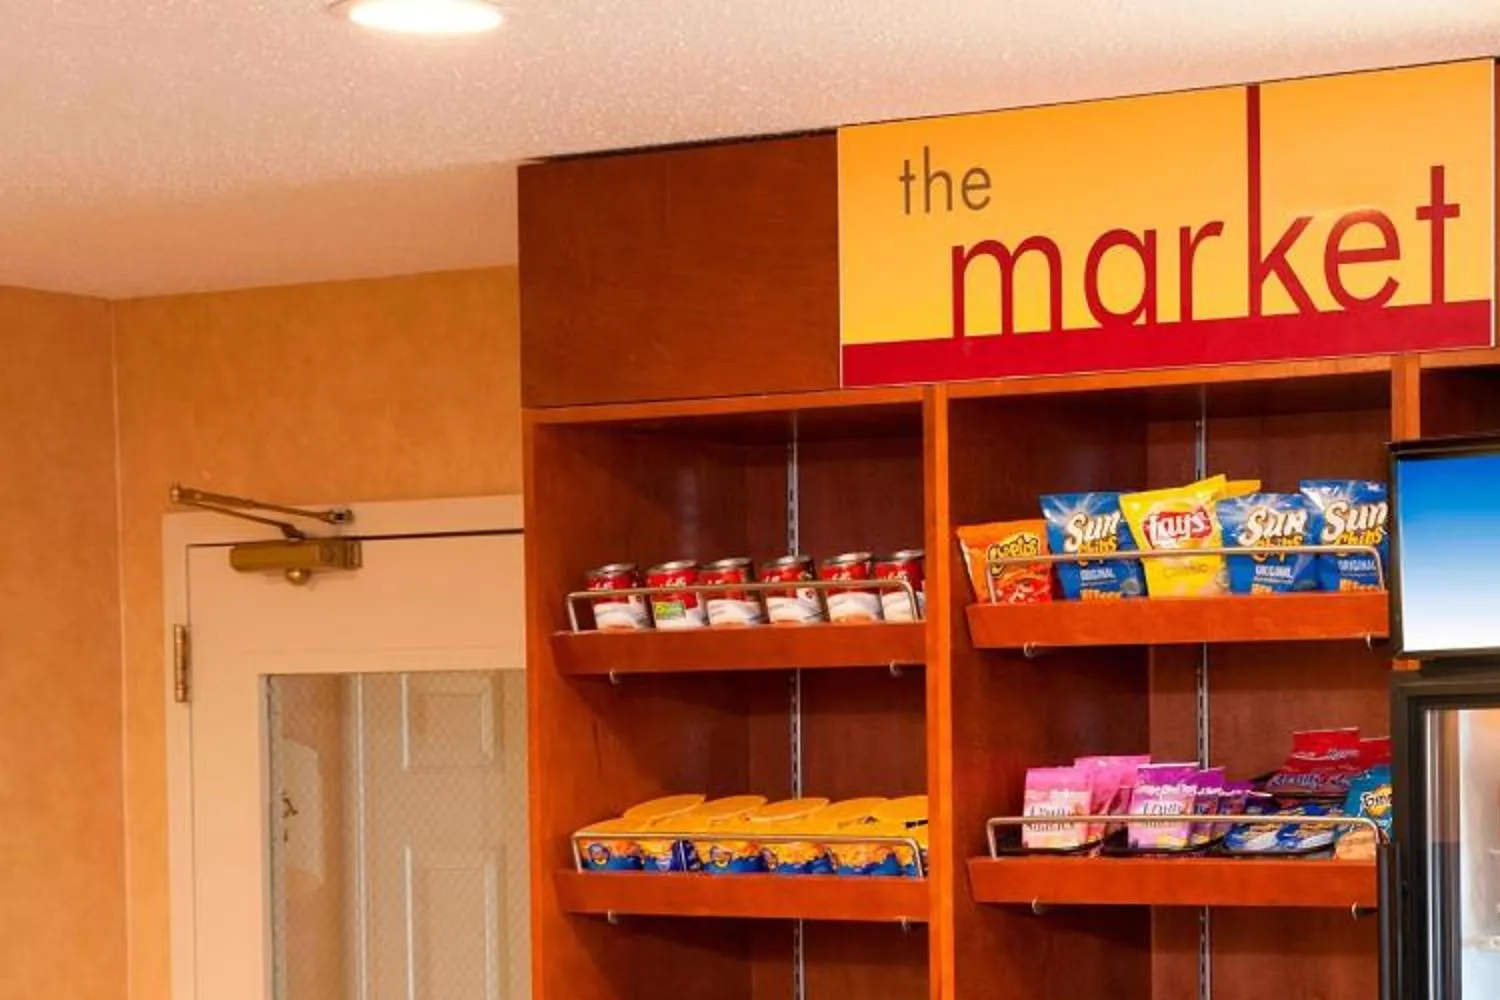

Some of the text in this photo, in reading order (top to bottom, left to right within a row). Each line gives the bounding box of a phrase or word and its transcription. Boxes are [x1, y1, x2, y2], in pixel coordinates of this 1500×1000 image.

[899, 145, 992, 215] the
[950, 83, 1461, 340] market
[1064, 510, 1119, 552] Sun
[1238, 506, 1308, 547] Sun
[1321, 500, 1389, 545] Sun
